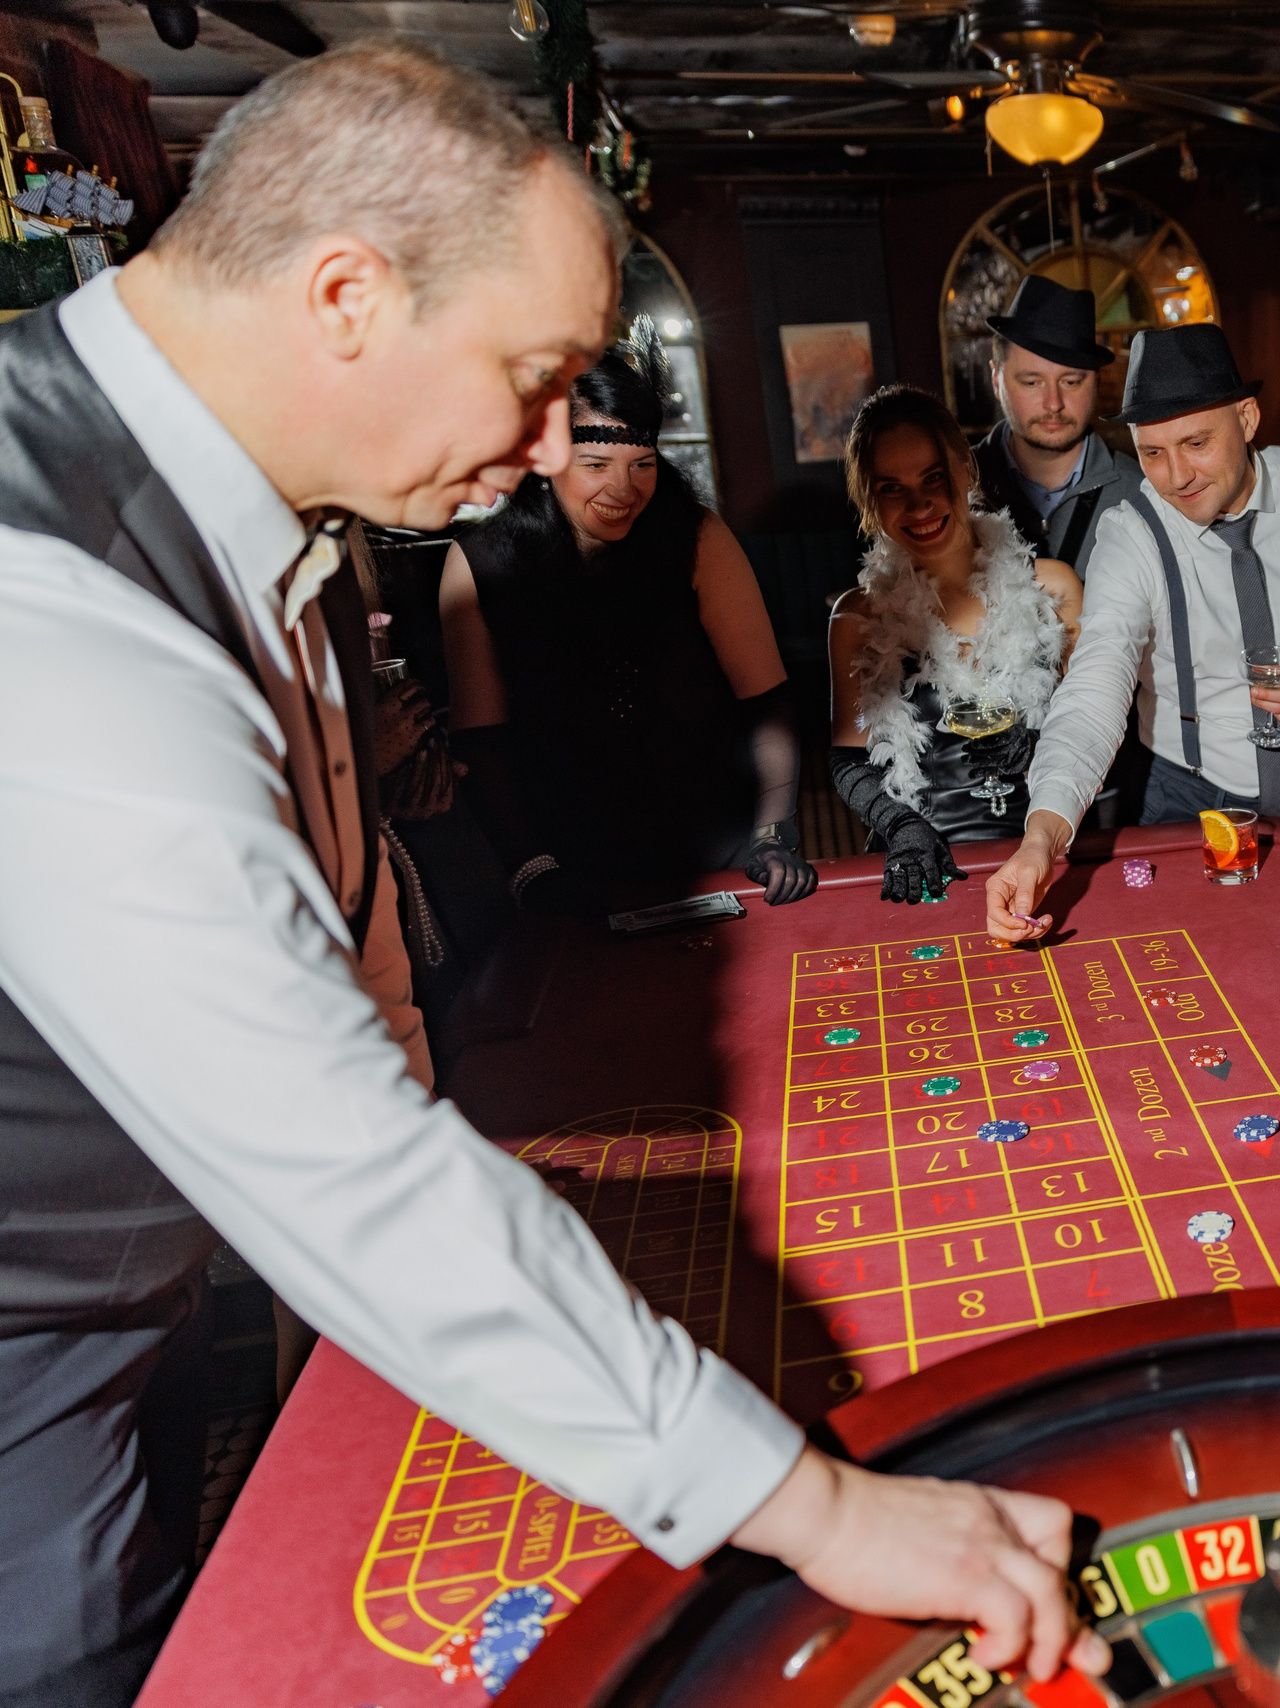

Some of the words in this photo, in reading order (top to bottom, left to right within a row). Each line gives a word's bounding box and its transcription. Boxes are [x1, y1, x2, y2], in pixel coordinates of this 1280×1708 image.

[984, 957, 1022, 972] 34
[1140, 940, 1179, 971] 19-36
[816, 975, 856, 991] 36
[902, 966, 940, 983] 35
[1084, 961, 1115, 1001] Dozen
[905, 990, 944, 1007] 32
[992, 980, 1028, 996] 31
[816, 1000, 857, 1018] 33
[994, 1005, 1038, 1023] 28
[906, 1016, 949, 1035] 29
[814, 1056, 858, 1077] 27
[908, 1043, 954, 1065] 26
[812, 1090, 862, 1113] 24
[1129, 1066, 1171, 1122] Dozen
[1021, 1098, 1064, 1121] 19
[916, 1110, 968, 1135] 20
[817, 1125, 861, 1150] 21
[1029, 1132, 1076, 1158] 16
[662, 1156, 687, 1171] 24
[926, 1147, 974, 1174] 17
[814, 1164, 861, 1191] 18
[1041, 1170, 1093, 1198] 13
[930, 1188, 978, 1216] 14
[814, 1205, 866, 1234] 15
[1054, 1219, 1109, 1249] 10
[938, 1237, 989, 1268] 11
[815, 1257, 867, 1289] 12
[1086, 1270, 1112, 1298] 7
[957, 1289, 987, 1319] 8
[393, 1523, 422, 1543] 15
[453, 1510, 492, 1535] 15
[1194, 1525, 1252, 1582] 32
[1135, 1544, 1171, 1596] 0
[438, 1586, 478, 1605] 0
[917, 1641, 993, 1708] 35
